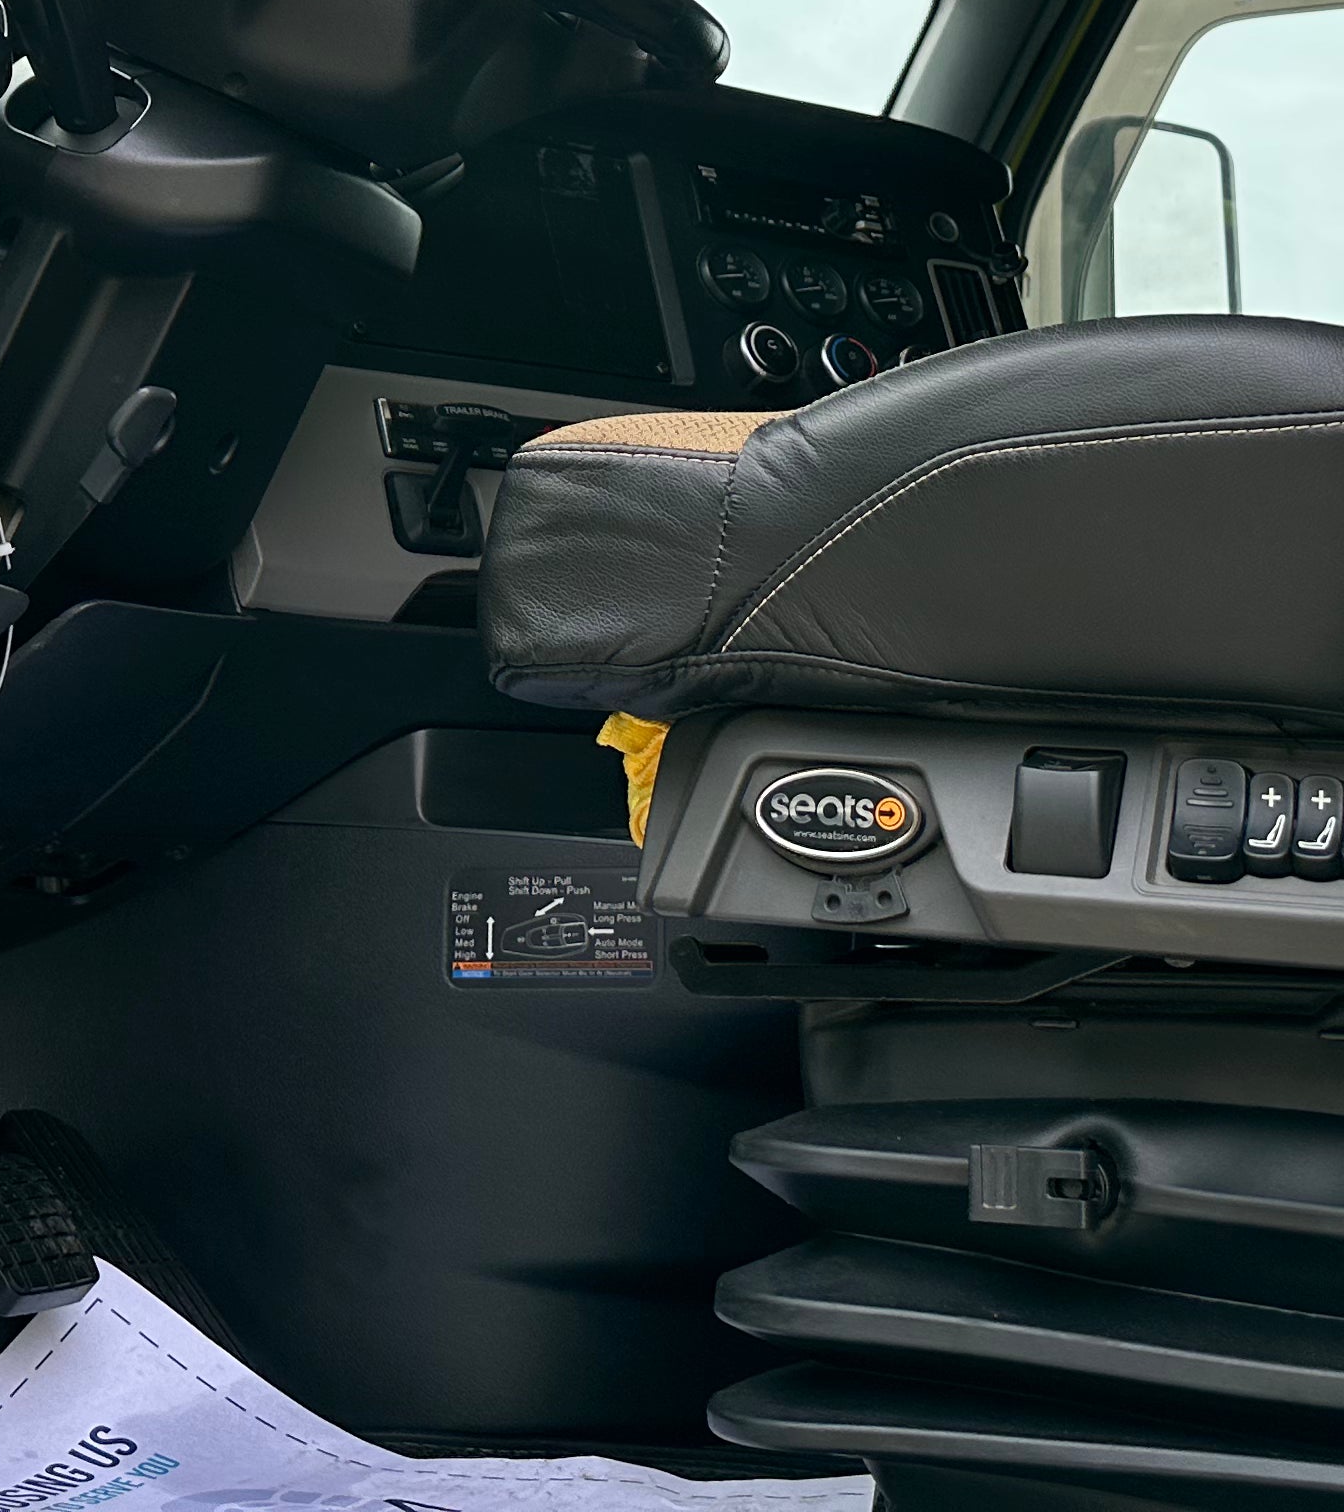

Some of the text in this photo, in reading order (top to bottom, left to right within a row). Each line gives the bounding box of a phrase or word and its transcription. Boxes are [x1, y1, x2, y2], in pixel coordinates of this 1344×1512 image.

[444, 406, 511, 422] TRAILER BRAKE
[770, 792, 875, 829] seats
[793, 830, 877, 843] www.seatsinc.com
[508, 876, 530, 886] Shift
[532, 877, 546, 887] Up
[554, 876, 572, 886] Pull
[508, 886, 530, 896] Shift
[531, 886, 558, 896] Down
[566, 886, 591, 895] Push
[452, 892, 483, 903] Engine
[452, 902, 478, 912] Brake
[593, 901, 626, 910] Manual
[455, 914, 470, 924] Off
[593, 913, 642, 925] Long Press
[455, 927, 474, 936] Low
[455, 939, 475, 947] Med
[594, 939, 644, 947] Auto Mode
[454, 950, 477, 961] High
[594, 950, 648, 960] Short Press
[67, 1425, 138, 1469] US
[78, 1476, 145, 1505] SERVE
[123, 1453, 181, 1480] YOU
